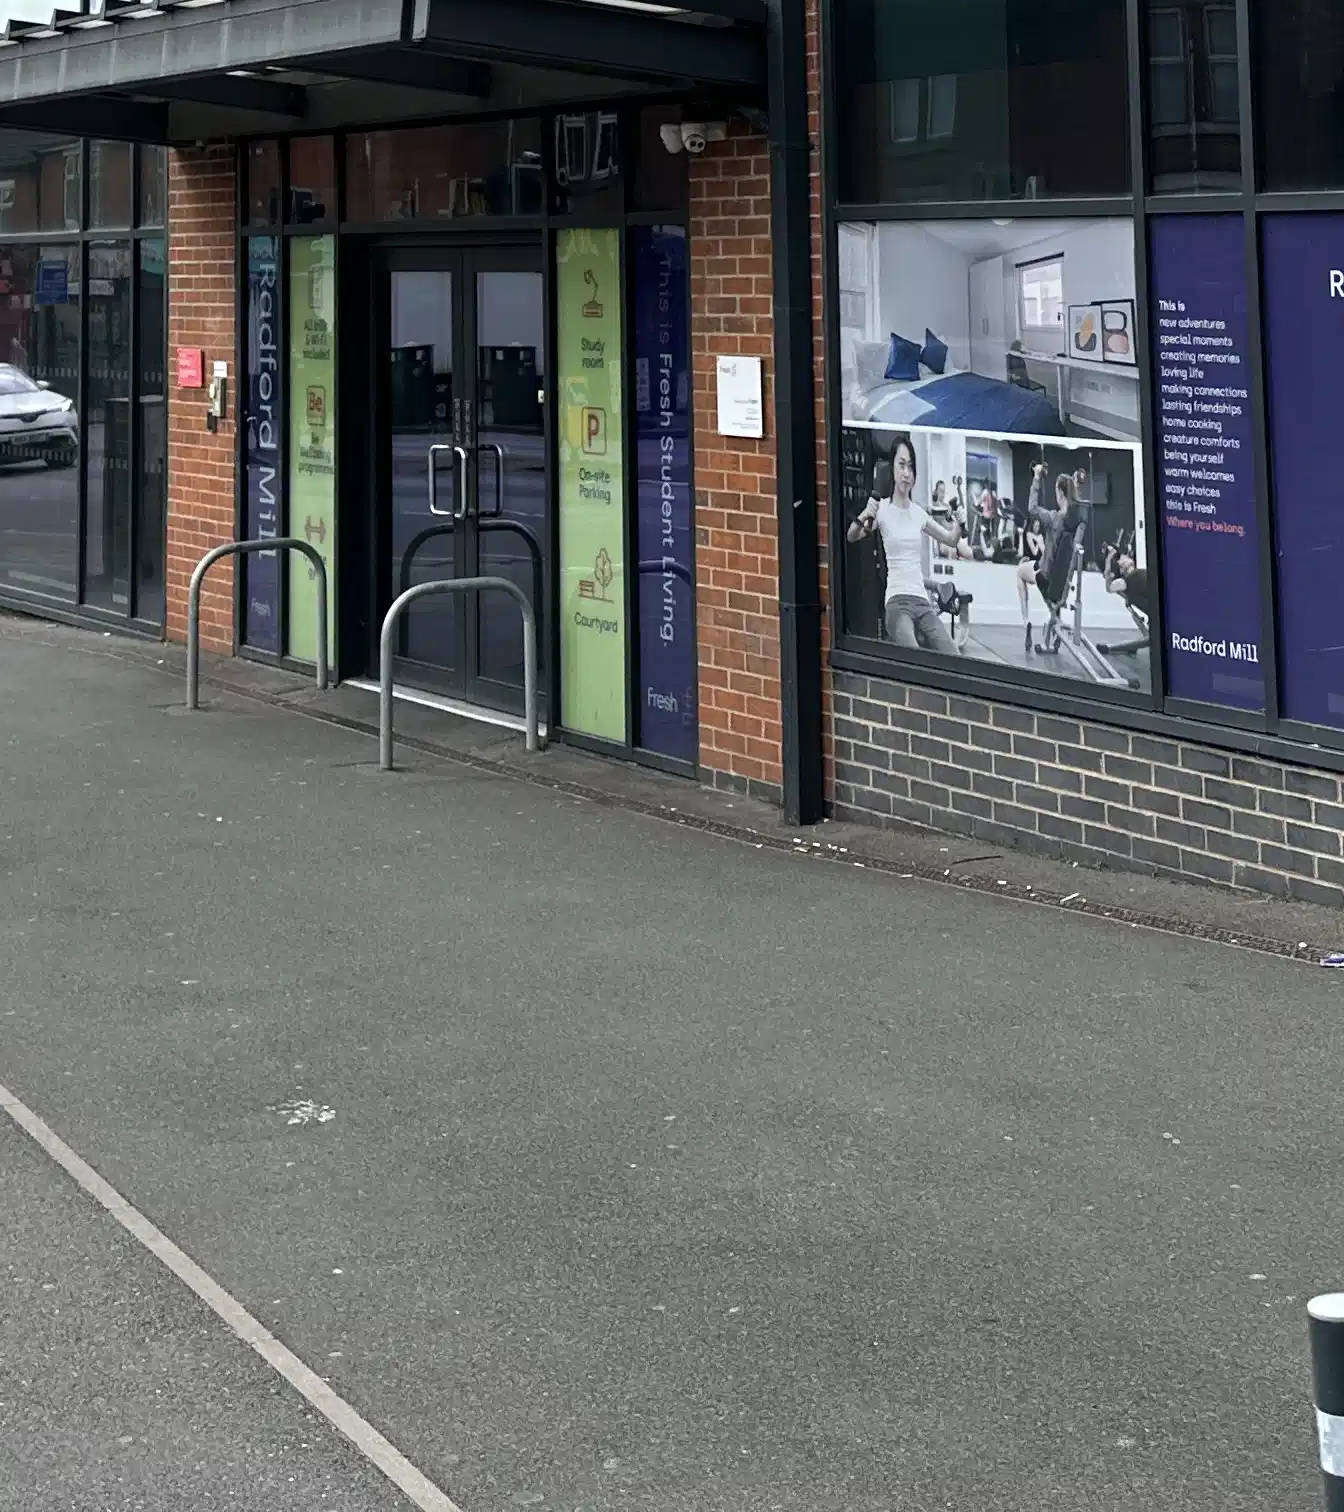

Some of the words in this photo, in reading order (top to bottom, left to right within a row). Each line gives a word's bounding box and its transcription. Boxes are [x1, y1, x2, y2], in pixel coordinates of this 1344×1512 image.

[658, 251, 673, 313] This
[1159, 299, 1176, 311] This
[1159, 318, 1177, 328] new
[1178, 317, 1226, 330] adventures
[659, 321, 673, 345] is
[1159, 334, 1192, 346] special
[1193, 336, 1233, 347] moments
[581, 338, 605, 356] Study
[259, 263, 277, 449] Radford
[1160, 351, 1196, 364] creating
[1197, 353, 1241, 364] memories
[1161, 365, 1188, 381] loving
[1188, 367, 1205, 379] life
[659, 353, 674, 427] Fresh
[1161, 384, 1193, 398] making
[1194, 386, 1248, 398] connections
[1162, 398, 1192, 415] lasting
[1193, 400, 1242, 416] friendships
[1162, 416, 1186, 428] home
[1187, 418, 1223, 433] cooking
[1163, 433, 1199, 445] creature
[1200, 436, 1240, 449] comforts
[1164, 448, 1188, 464] being
[1189, 452, 1224, 464] yourself
[1164, 468, 1189, 478] warm
[1190, 468, 1235, 482] welcomes
[579, 484, 611, 505] Parking
[660, 436, 675, 548] Student
[1165, 483, 1186, 497] easy
[1186, 484, 1221, 498] choices
[258, 466, 277, 560] Mill
[1193, 501, 1216, 514] Fresh
[1166, 516, 1193, 528] Where
[1194, 521, 1211, 532] you
[659, 557, 676, 647] Living.
[574, 612, 618, 633] Courtyard
[1172, 631, 1226, 658] Radford
[1229, 641, 1259, 663] Mill
[647, 687, 679, 713] Fresh
